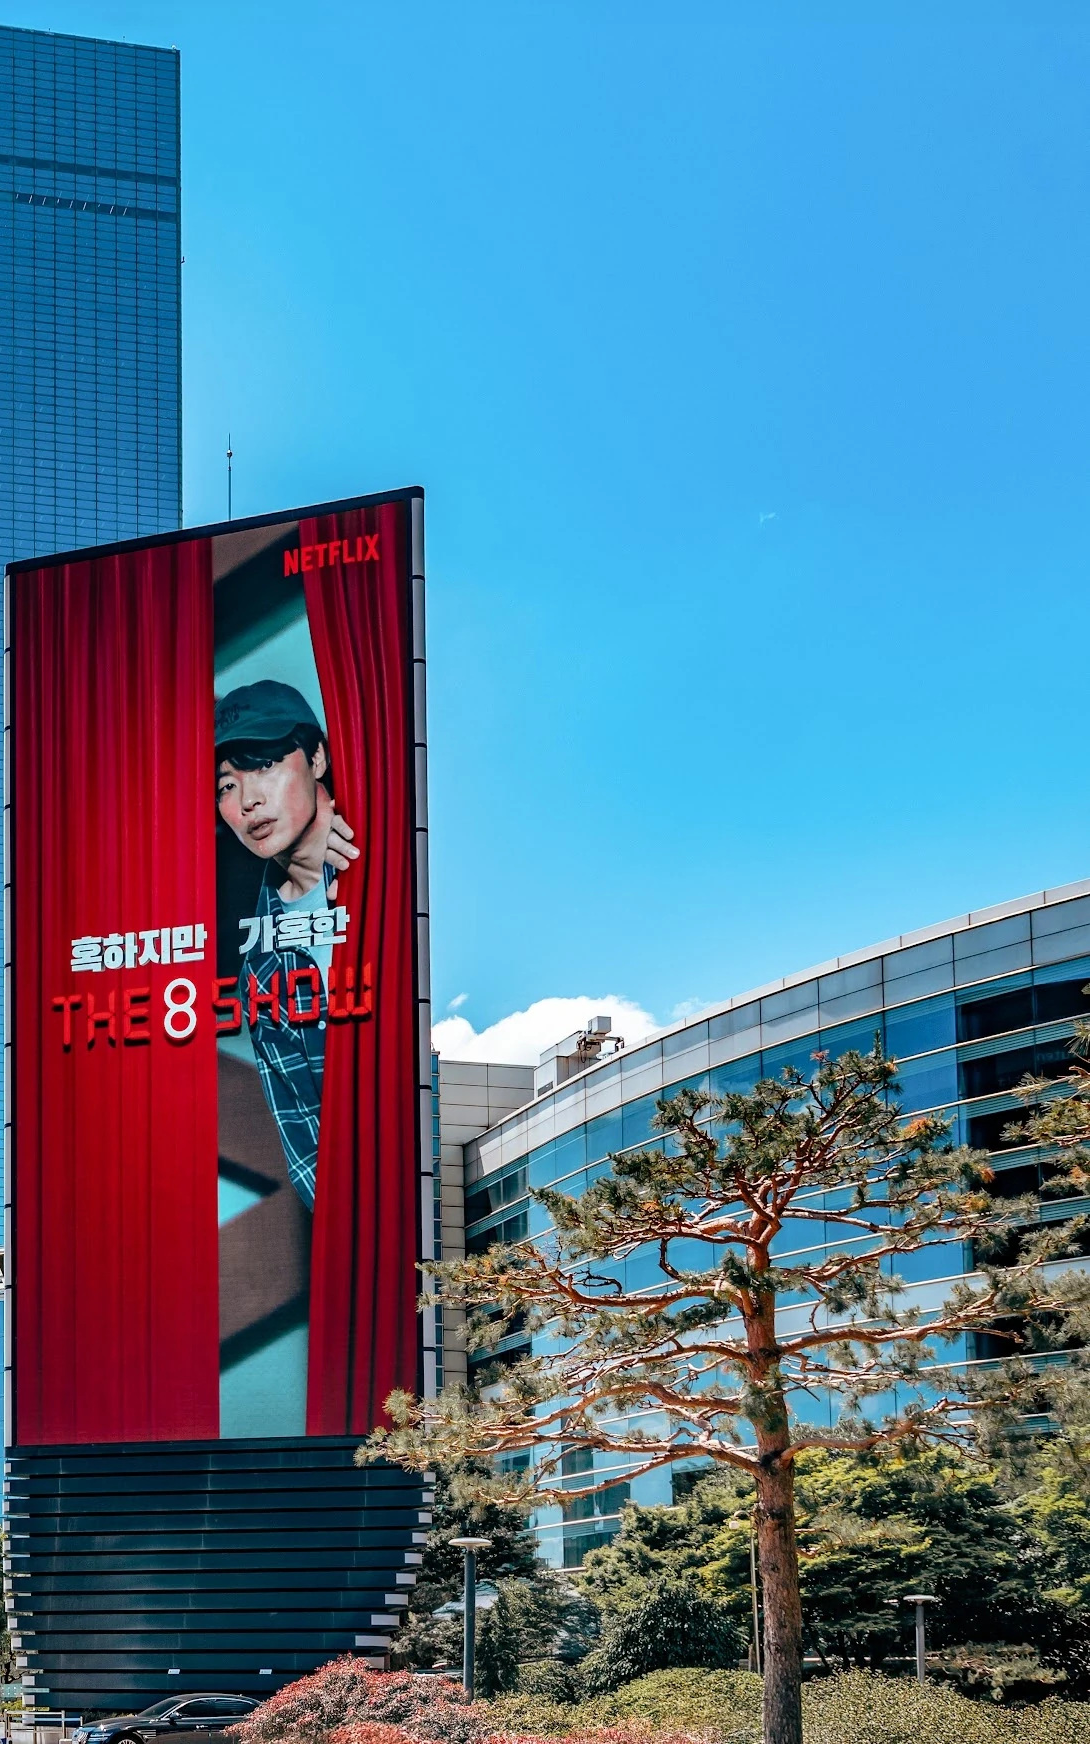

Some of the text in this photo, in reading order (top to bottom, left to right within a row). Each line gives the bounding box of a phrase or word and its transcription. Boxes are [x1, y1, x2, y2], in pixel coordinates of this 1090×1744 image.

[284, 534, 379, 577] NETFLIX
[71, 906, 350, 972] 혹하지만 가혹한
[53, 962, 373, 1047] THE 8 SHOW
